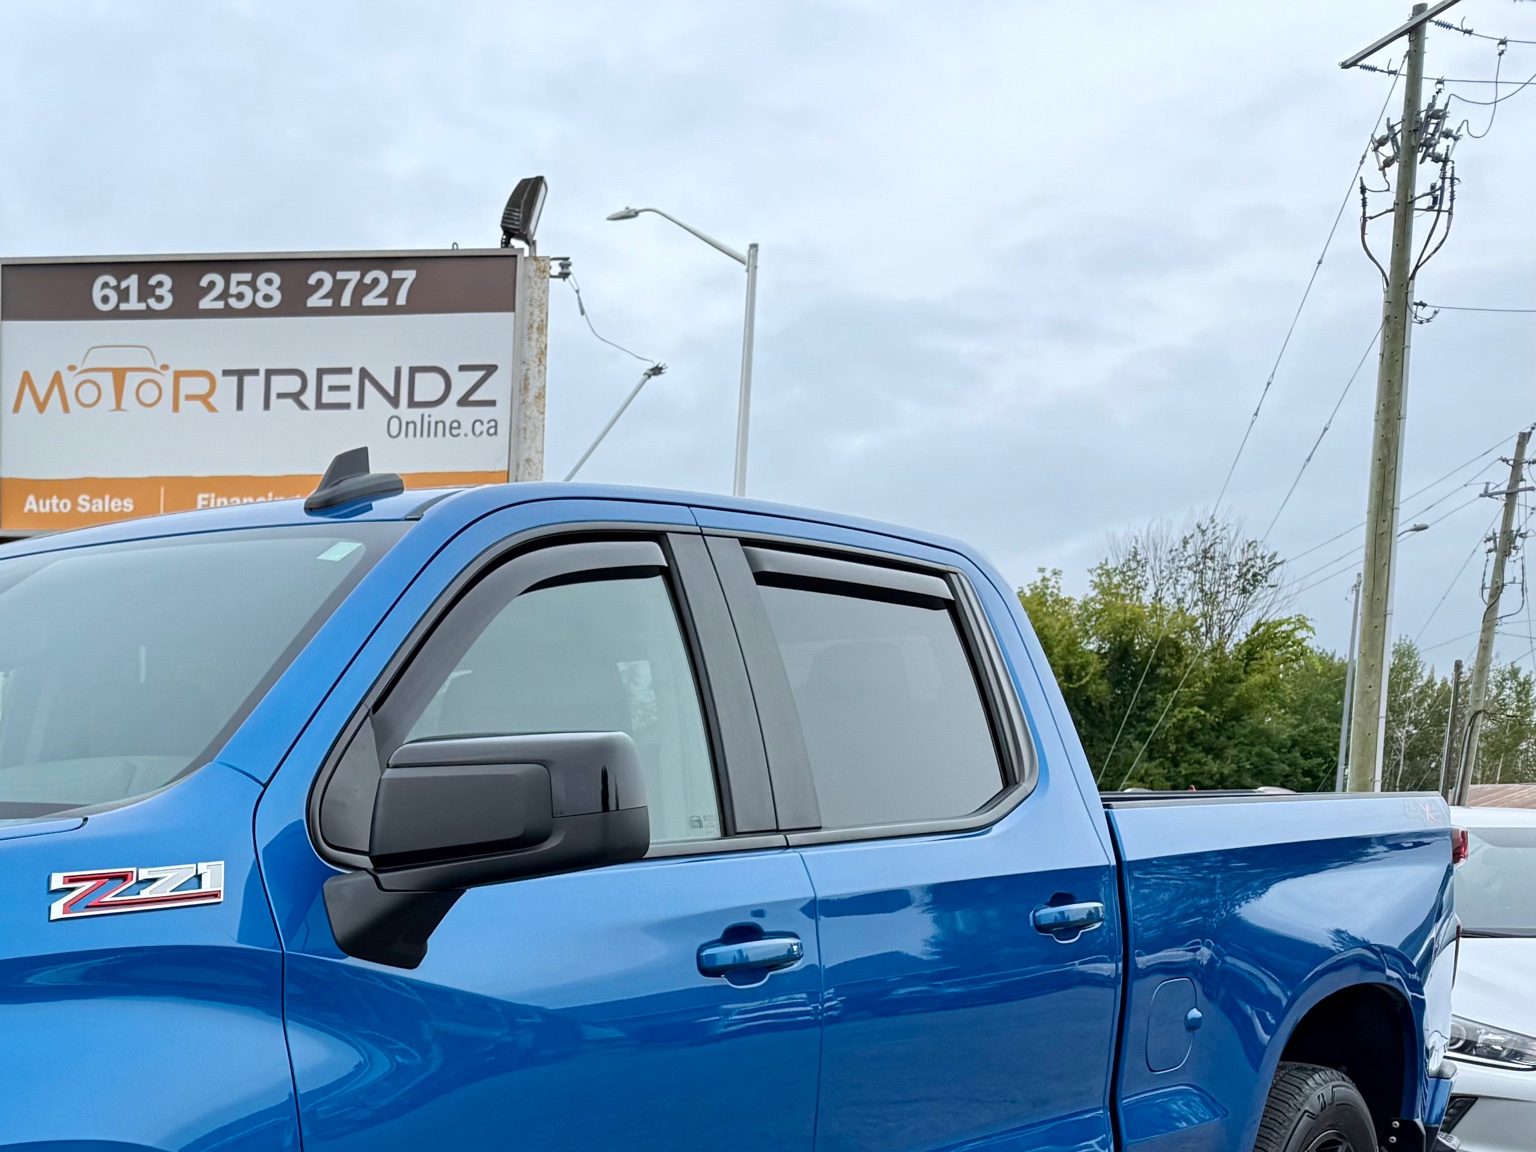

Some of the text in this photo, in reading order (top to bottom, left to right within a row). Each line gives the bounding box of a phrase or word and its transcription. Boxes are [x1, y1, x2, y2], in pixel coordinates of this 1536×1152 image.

[91, 269, 417, 312] 613 258 2727
[386, 413, 499, 440] Online.ca
[24, 494, 135, 513] Auto Sales
[48, 860, 225, 921] Z71
